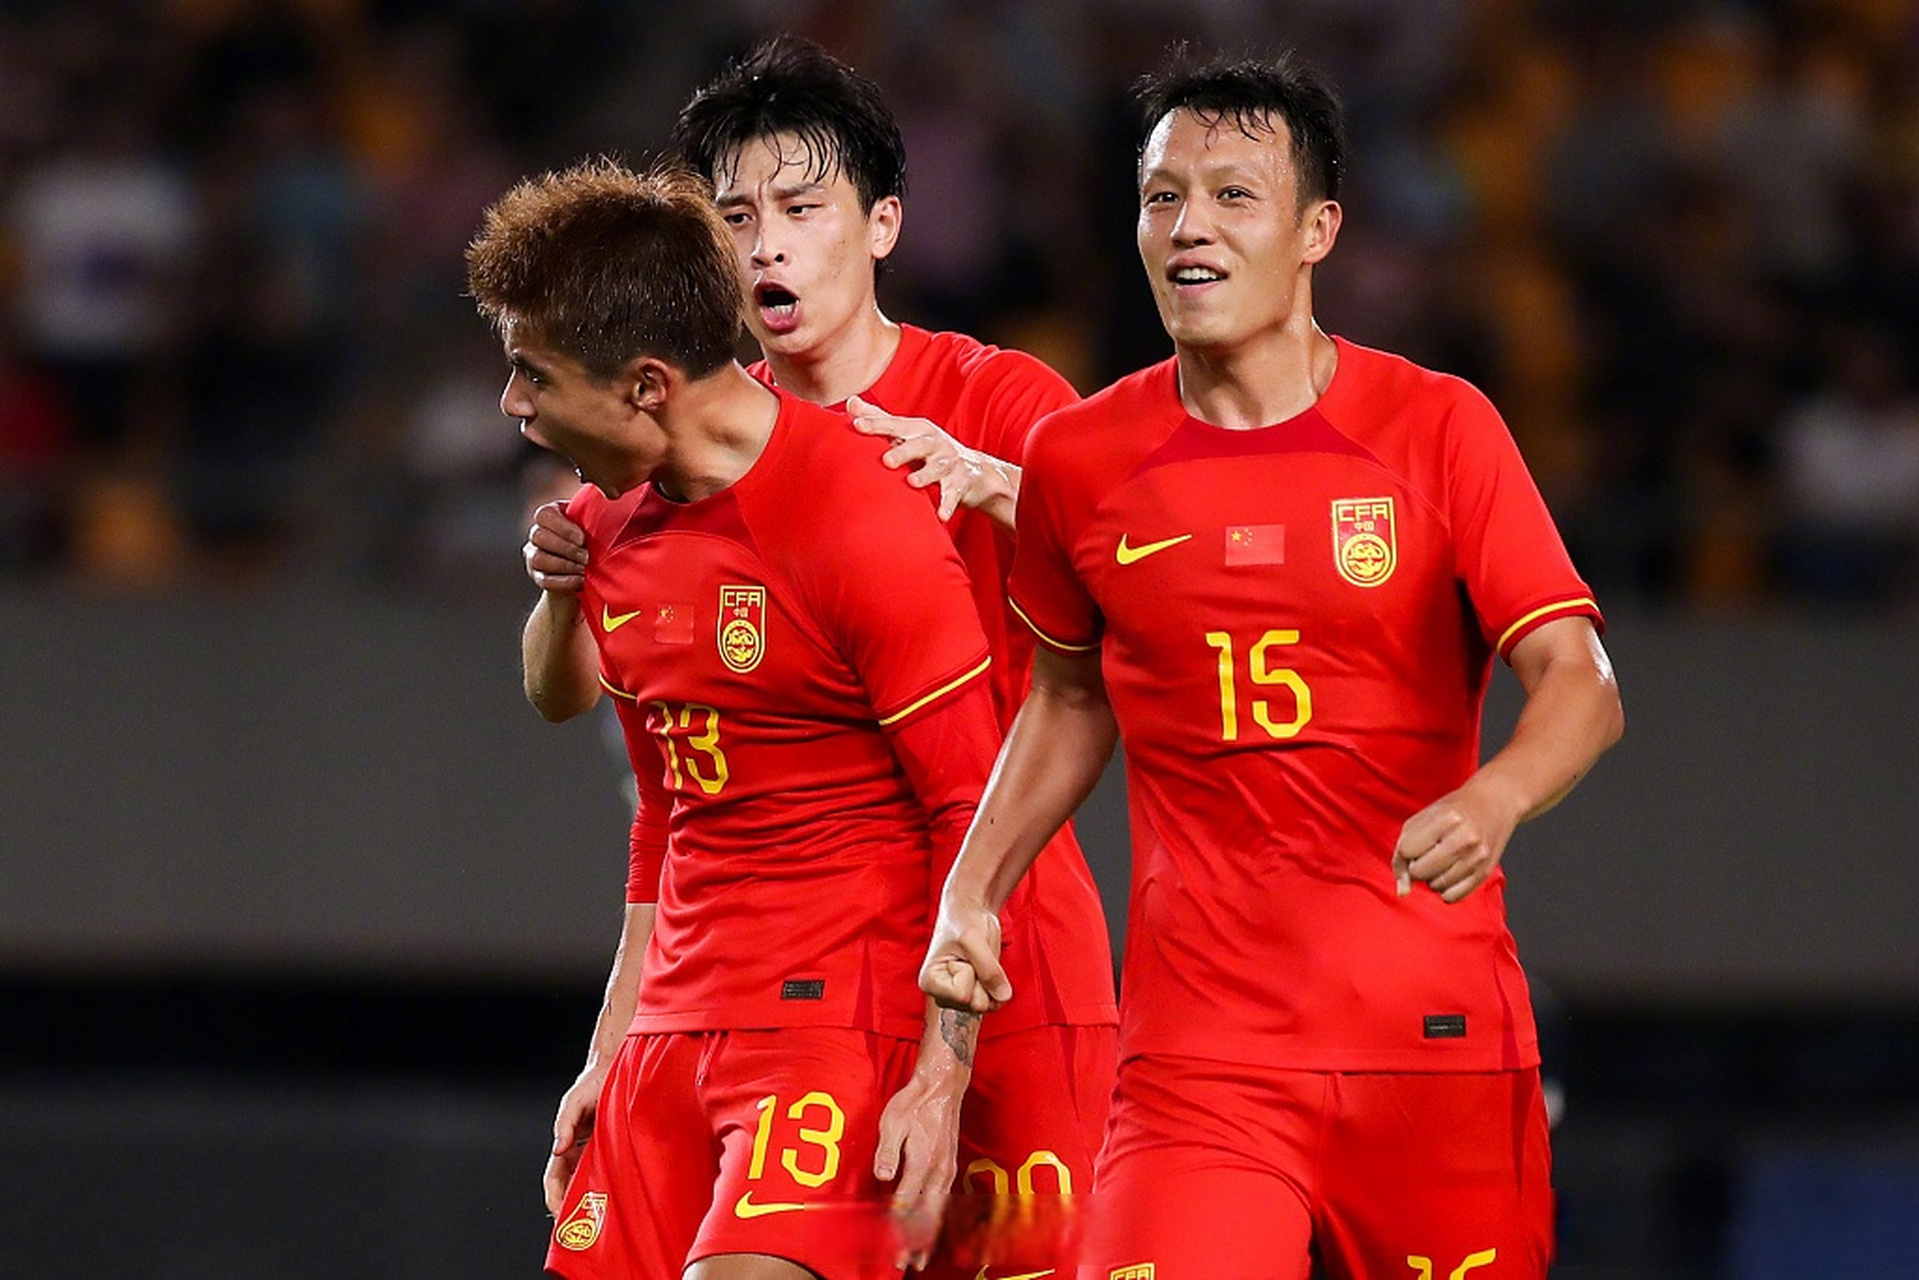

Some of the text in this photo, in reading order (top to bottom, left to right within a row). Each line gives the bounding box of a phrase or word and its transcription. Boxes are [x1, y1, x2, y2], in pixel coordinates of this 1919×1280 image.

[1338, 504, 1388, 521] CFA
[724, 591, 761, 607] CFA
[1206, 630, 1312, 740] 15
[651, 701, 729, 794] 13
[748, 1091, 845, 1188] 13
